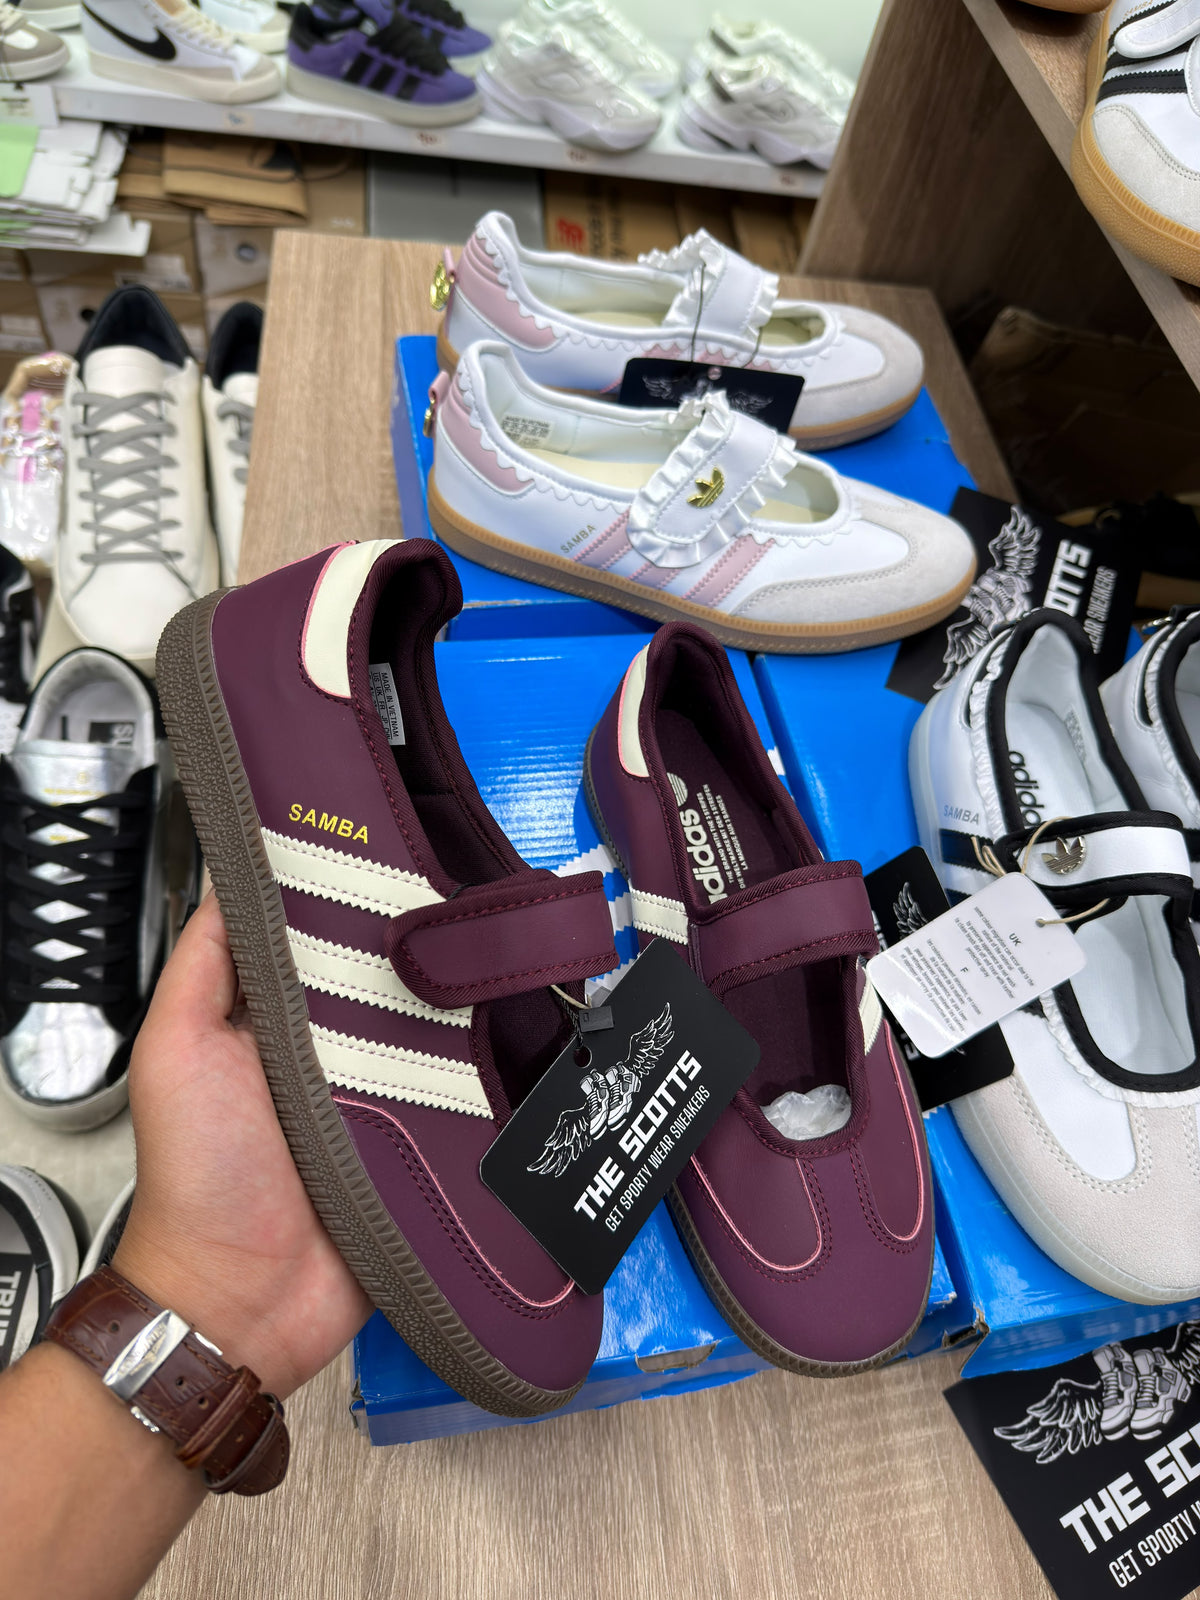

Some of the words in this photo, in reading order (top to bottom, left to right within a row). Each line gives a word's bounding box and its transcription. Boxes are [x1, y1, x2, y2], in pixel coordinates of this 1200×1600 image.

[560, 524, 596, 554] SAMBA
[1086, 565, 1118, 622] SNEAKERS
[1083, 618, 1105, 654] EAR
[372, 672, 379, 682] US
[375, 686, 382, 695] UK
[381, 671, 391, 693] MADE
[386, 705, 400, 737] VIETNAM
[696, 791, 710, 816] STRIPES
[702, 783, 717, 811] STREIFEN
[715, 794, 729, 819] BANDES
[289, 804, 368, 844] SAMBA
[707, 819, 716, 832] THE
[714, 815, 723, 828] DEN
[943, 804, 980, 826] SAMBA
[711, 832, 722, 848] WITH
[719, 828, 727, 839] MIT
[726, 822, 735, 835] AUX
[717, 848, 730, 870] BRAND
[723, 838, 742, 877] WELTMARKE
[730, 835, 745, 861] MARQUE
[726, 870, 734, 883] THE
[740, 860, 748, 870] LA
[737, 877, 746, 888] DIE
[1008, 932, 1021, 946] UK
[960, 966, 968, 974] F
[573, 1156, 625, 1221] THE
[618, 1049, 702, 1162] SCOTTS
[604, 1204, 625, 1232] GET
[620, 1163, 653, 1210] SPORTY
[647, 1134, 675, 1170] WEAR
[669, 1084, 711, 1139] SNEAKERS
[1059, 1471, 1151, 1554] THE
[1144, 1422, 1200, 1498] SC
[1108, 1548, 1142, 1588] GET
[1137, 1509, 1197, 1567] SPORTY
